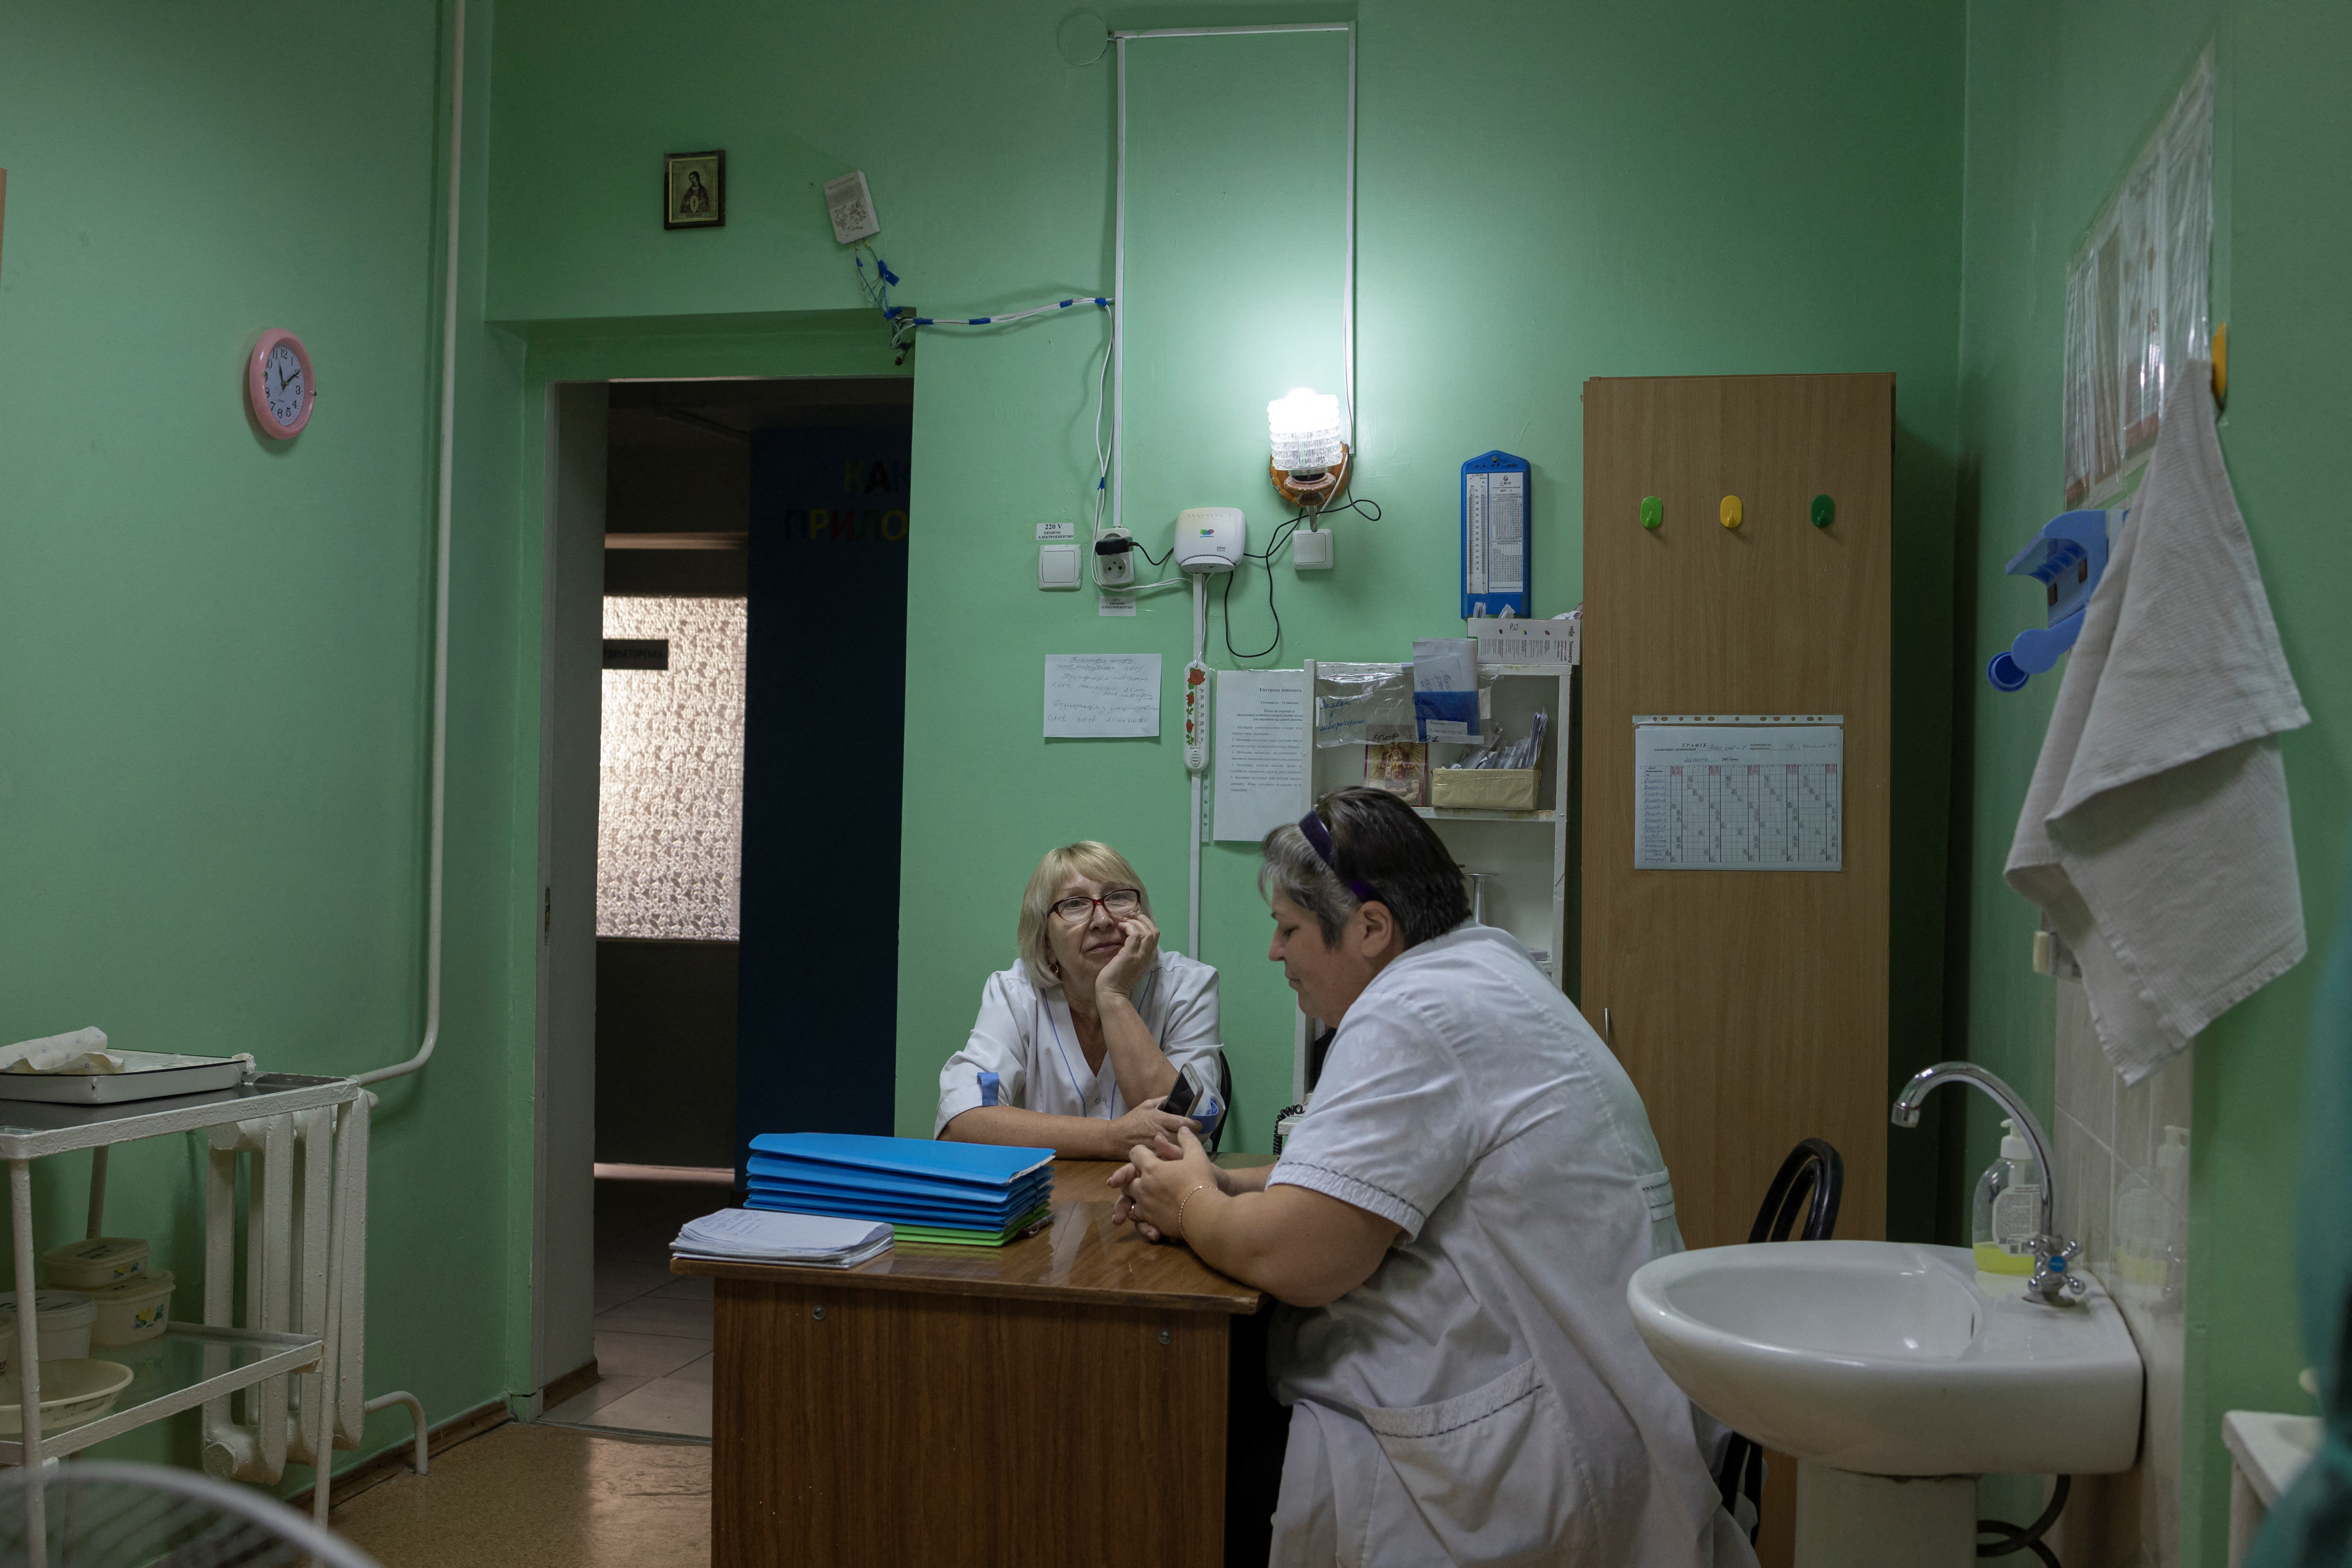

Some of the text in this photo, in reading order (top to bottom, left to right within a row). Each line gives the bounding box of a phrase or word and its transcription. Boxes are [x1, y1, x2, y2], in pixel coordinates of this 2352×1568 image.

[272, 349, 278, 360] 11
[281, 348, 287, 359] 12
[291, 357, 293, 366] 1
[296, 385, 301, 395] 3
[270, 401, 276, 411] 7
[292, 399, 297, 409] 4
[278, 408, 283, 419] 6
[286, 407, 291, 417] 5
[1320, 699, 1351, 709] Заявки
